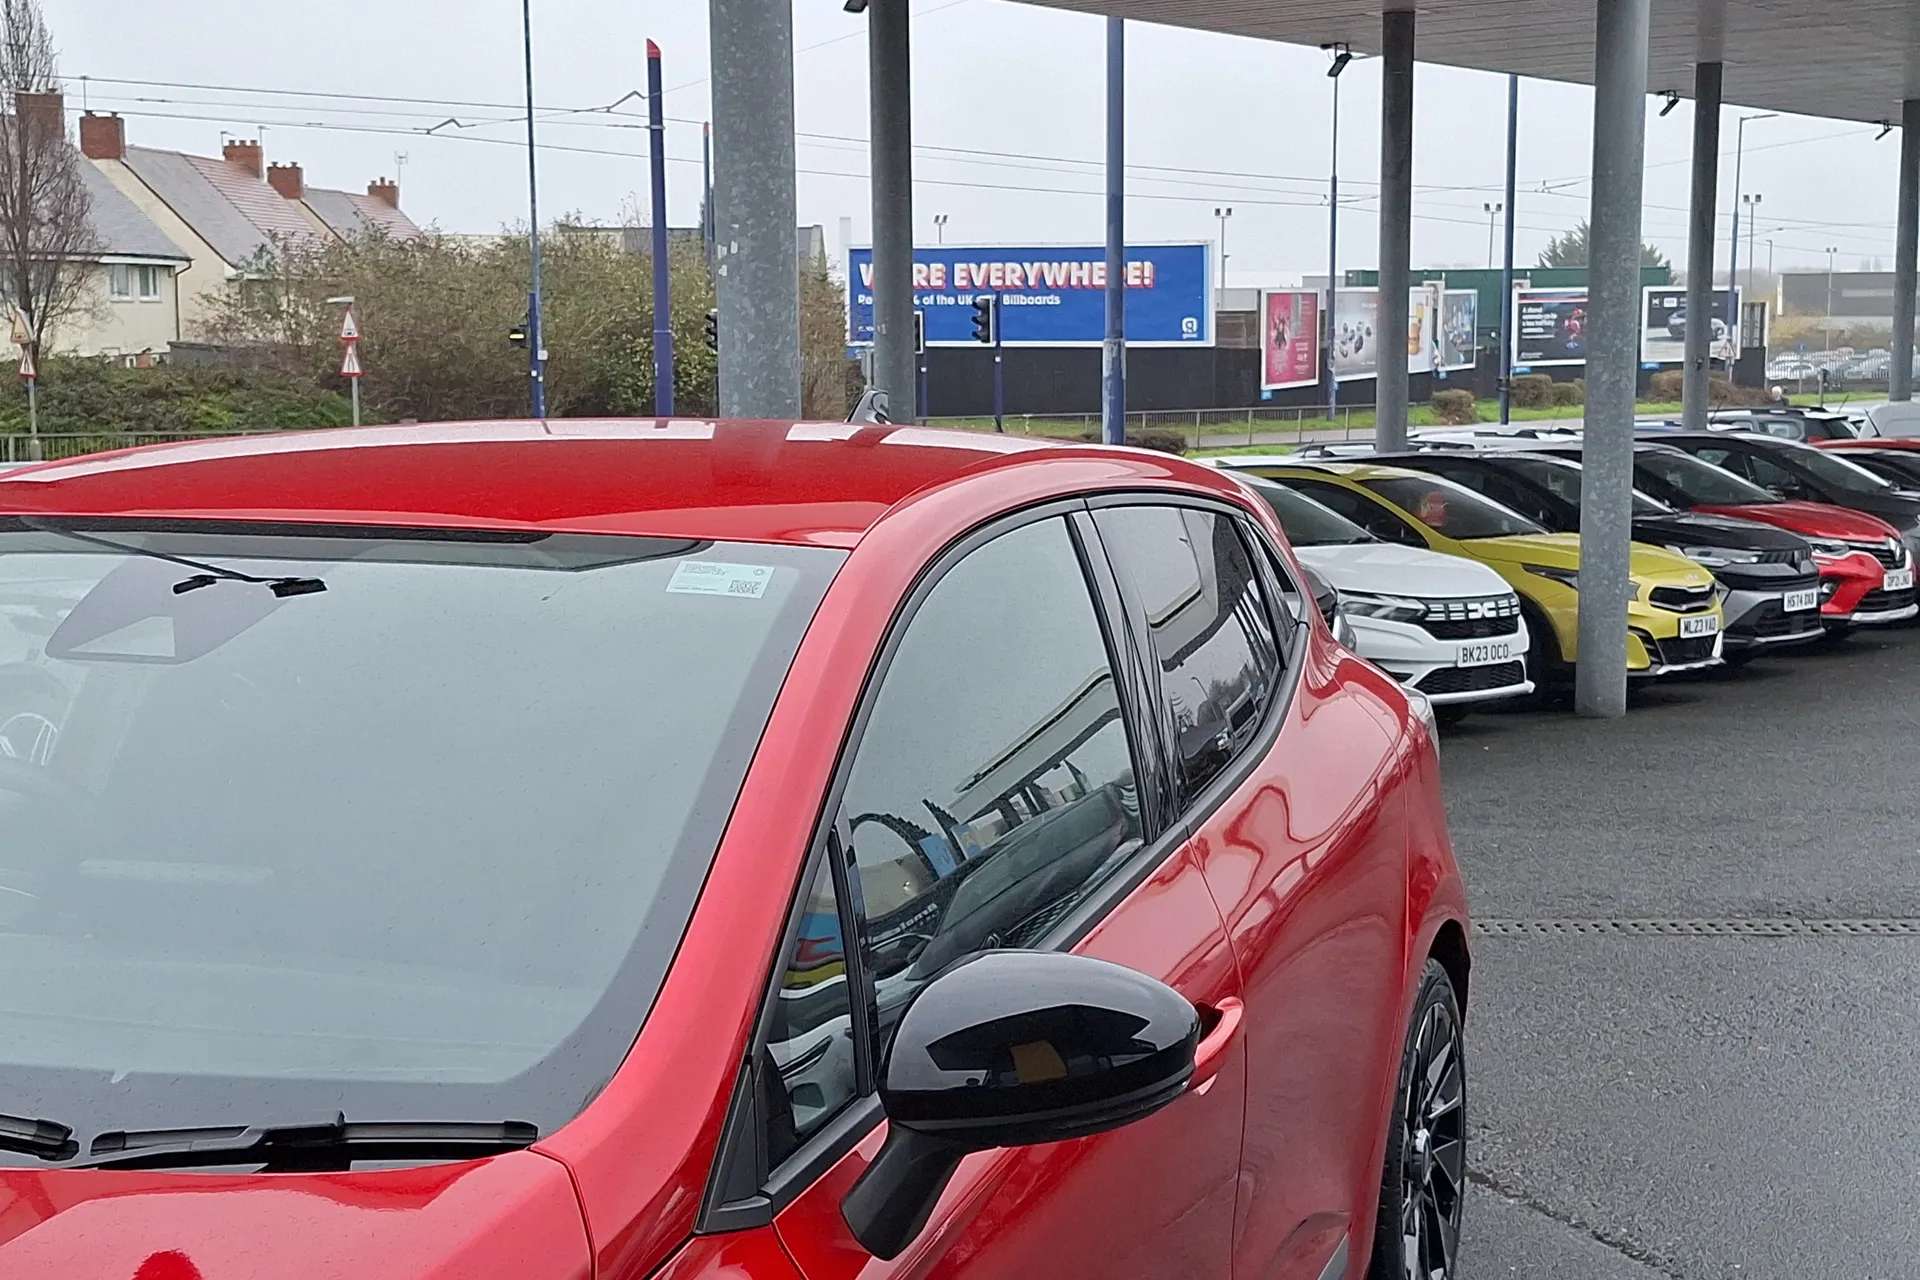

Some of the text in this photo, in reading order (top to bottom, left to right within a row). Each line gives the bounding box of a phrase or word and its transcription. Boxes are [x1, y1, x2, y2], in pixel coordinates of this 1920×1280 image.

[954, 261, 1154, 289] EVERYWHEE!
[922, 295, 935, 305] of
[936, 294, 955, 305] the
[957, 295, 973, 305] UK
[1002, 295, 1061, 305] Billboards
[1683, 619, 1703, 634] ML23
[1462, 645, 1488, 663] BK23
